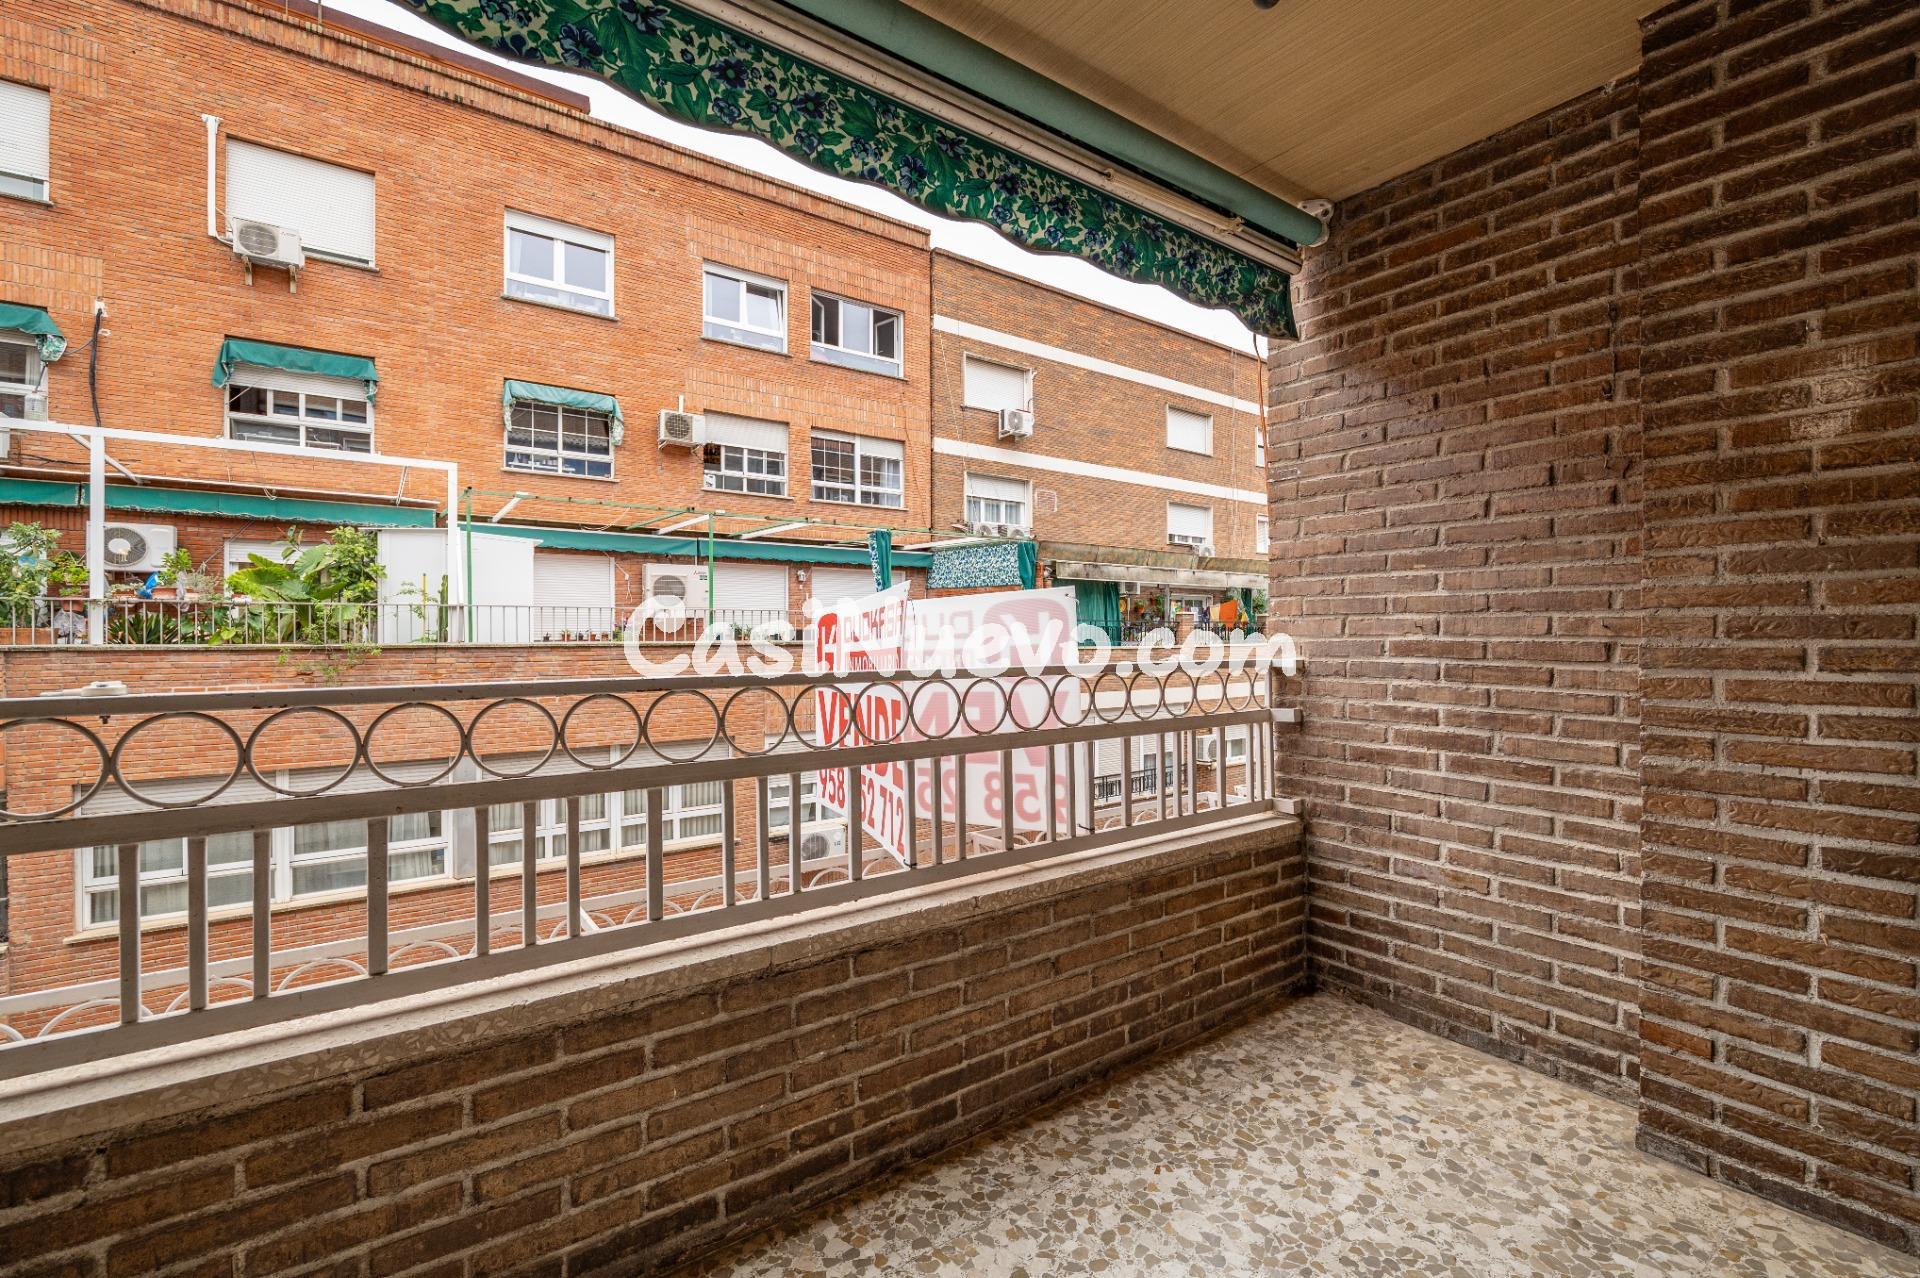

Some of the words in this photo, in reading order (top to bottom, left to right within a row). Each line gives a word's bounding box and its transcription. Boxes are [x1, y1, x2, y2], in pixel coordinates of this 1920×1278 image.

[818, 690, 904, 790] VENDE
[819, 767, 845, 809] 958
[880, 784, 904, 857] 712
